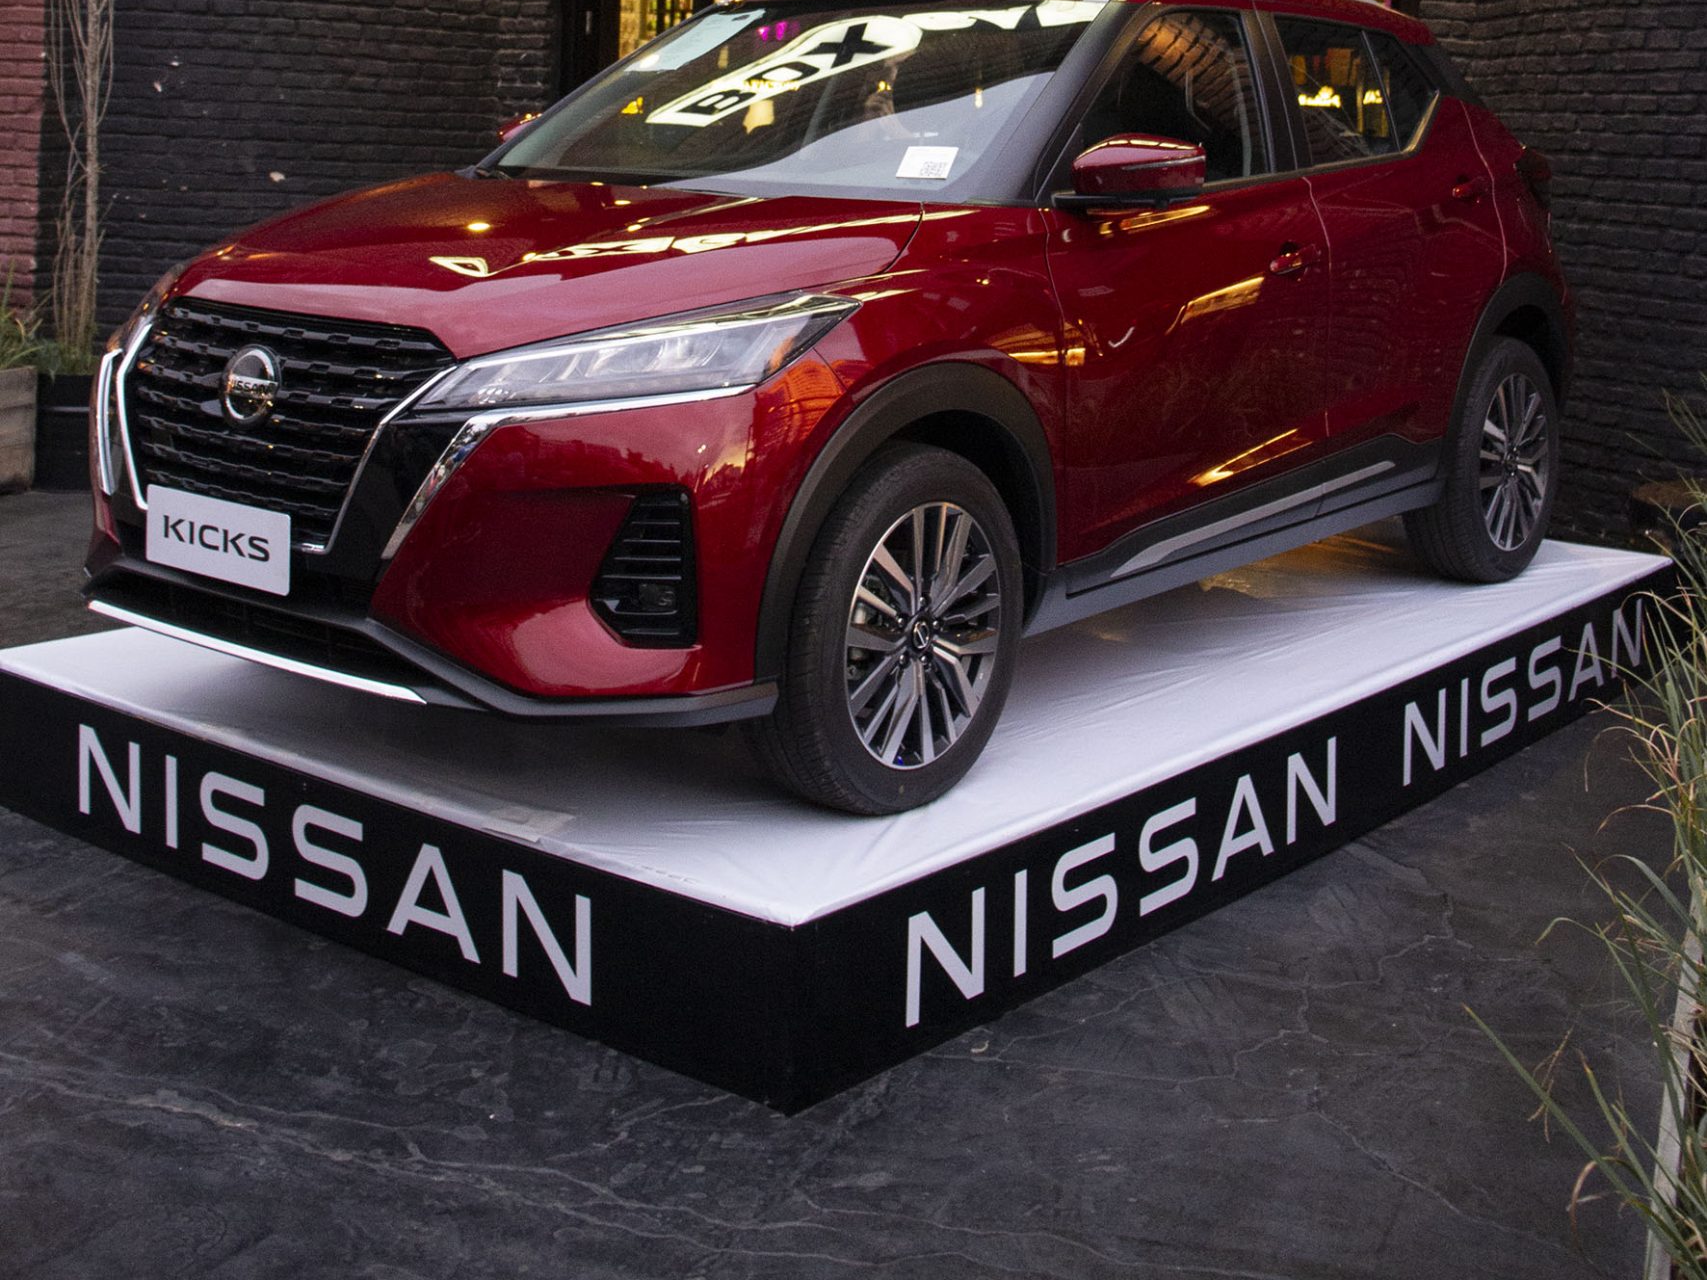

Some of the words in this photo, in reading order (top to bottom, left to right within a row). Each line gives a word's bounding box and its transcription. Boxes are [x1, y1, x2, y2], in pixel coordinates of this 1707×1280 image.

[162, 514, 271, 563] KICKS
[1402, 597, 1643, 788] NISSAN
[78, 722, 592, 1007] NISSAN
[905, 735, 1337, 1028] NISSAN
